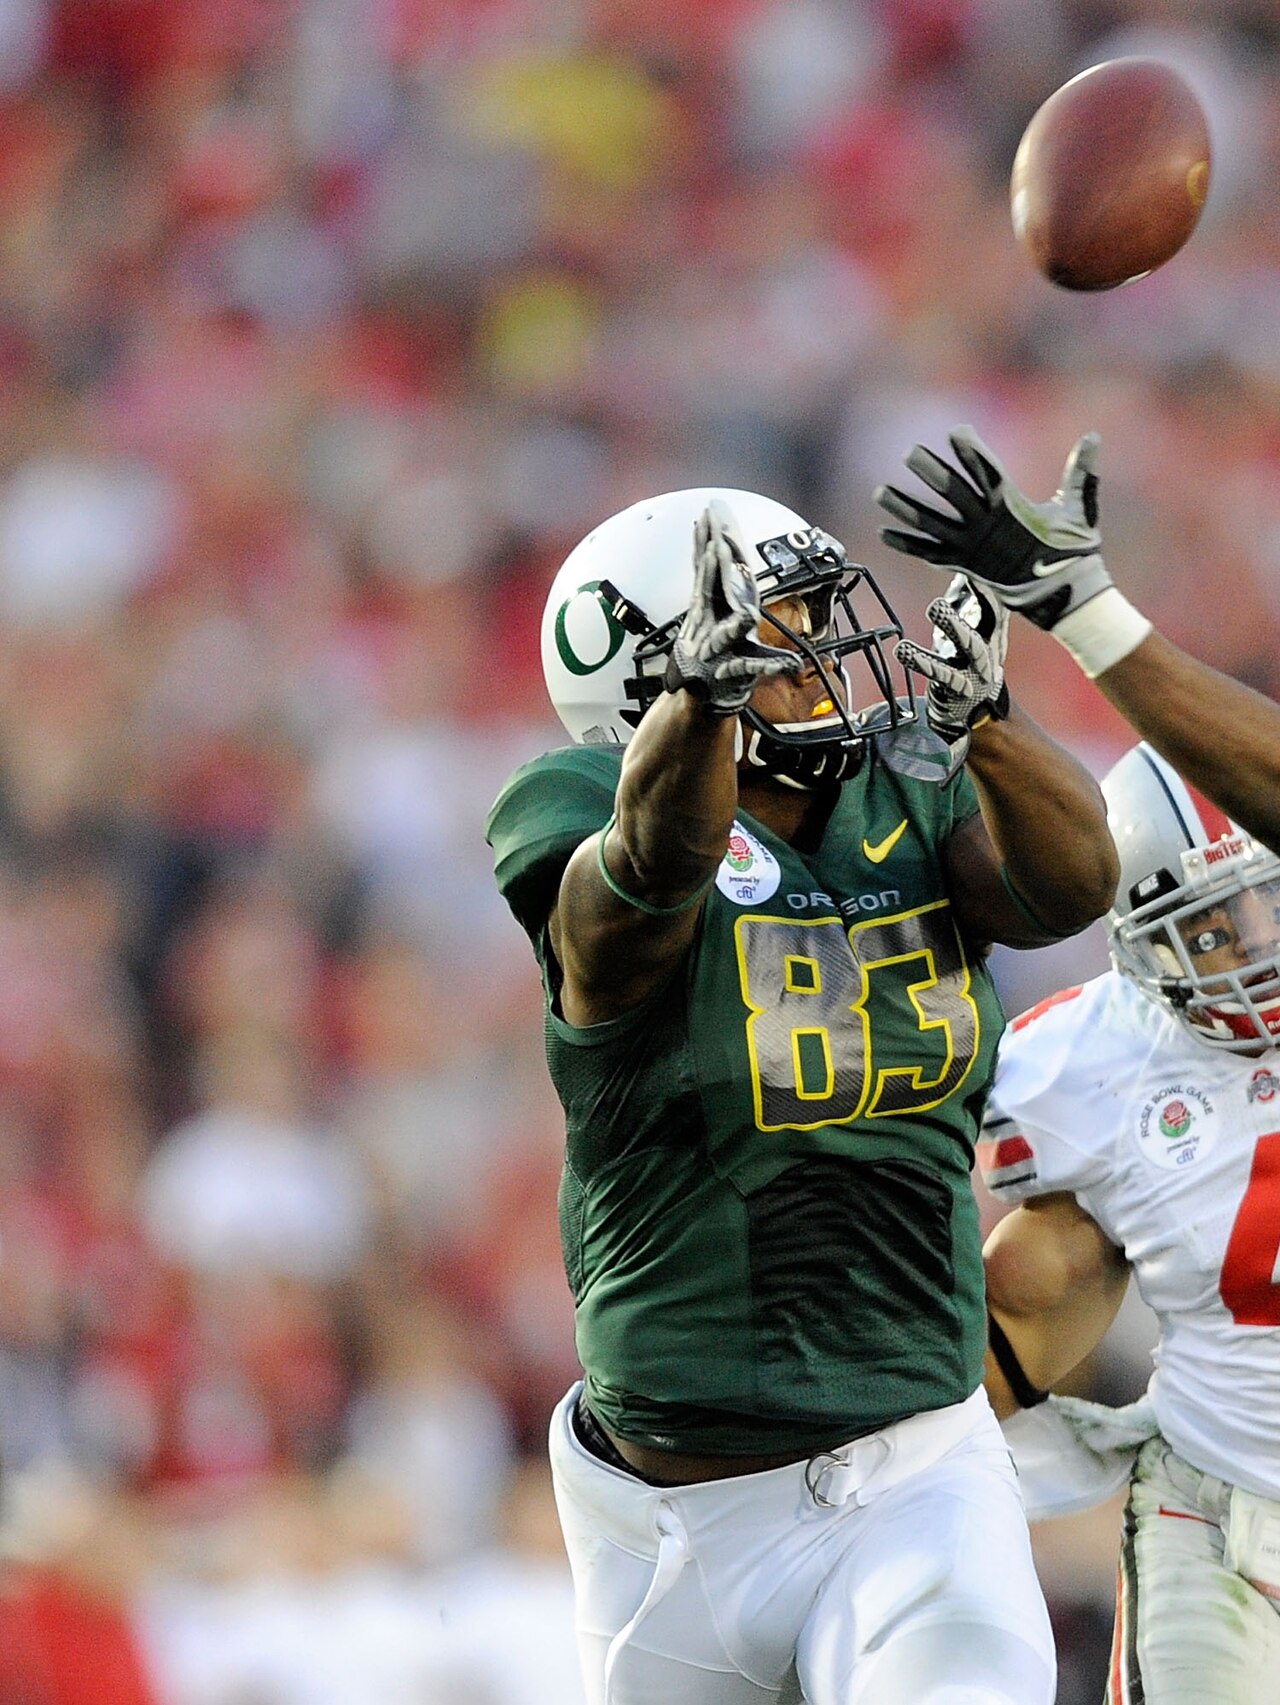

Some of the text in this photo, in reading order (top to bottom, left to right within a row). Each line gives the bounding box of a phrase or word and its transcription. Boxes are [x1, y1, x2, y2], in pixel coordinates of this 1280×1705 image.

[788, 531, 811, 549] O
[555, 580, 626, 676] O
[786, 890, 900, 915] ORGON
[734, 899, 979, 1132] 83
[1140, 1085, 1214, 1138] ROSE BOWL GAME
